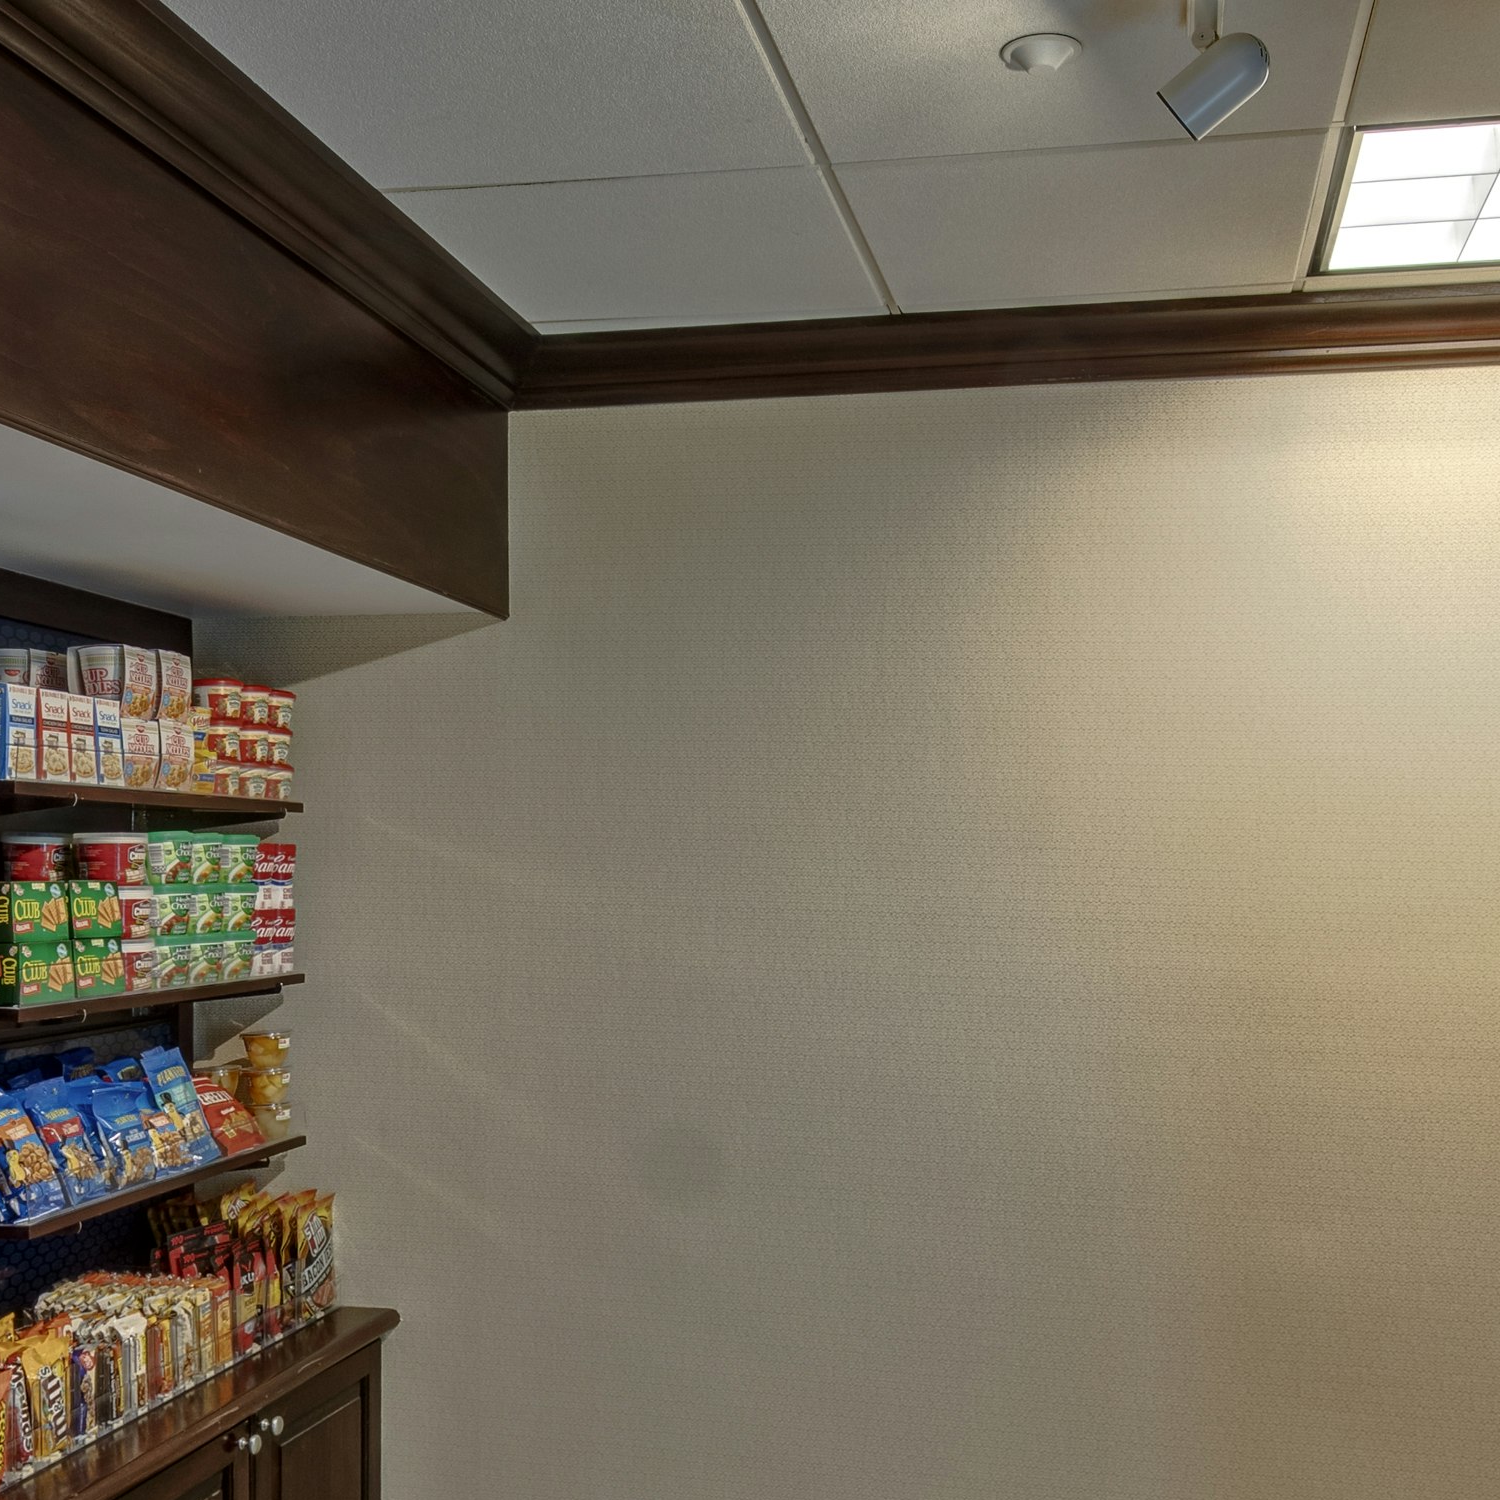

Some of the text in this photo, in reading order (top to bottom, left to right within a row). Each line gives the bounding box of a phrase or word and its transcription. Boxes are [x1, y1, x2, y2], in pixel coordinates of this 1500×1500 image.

[11, 699, 34, 711] Snack
[44, 703, 66, 716] Snack
[71, 706, 92, 719] Snack
[100, 711, 118, 723] Snack
[14, 898, 41, 921] CLUB
[73, 897, 97, 918] CLUB
[2, 957, 17, 985] CLUB
[22, 960, 48, 983] CLUB
[77, 955, 101, 976] CLUB
[303, 1212, 323, 1241] SLIM
[301, 1259, 324, 1288] BACON
